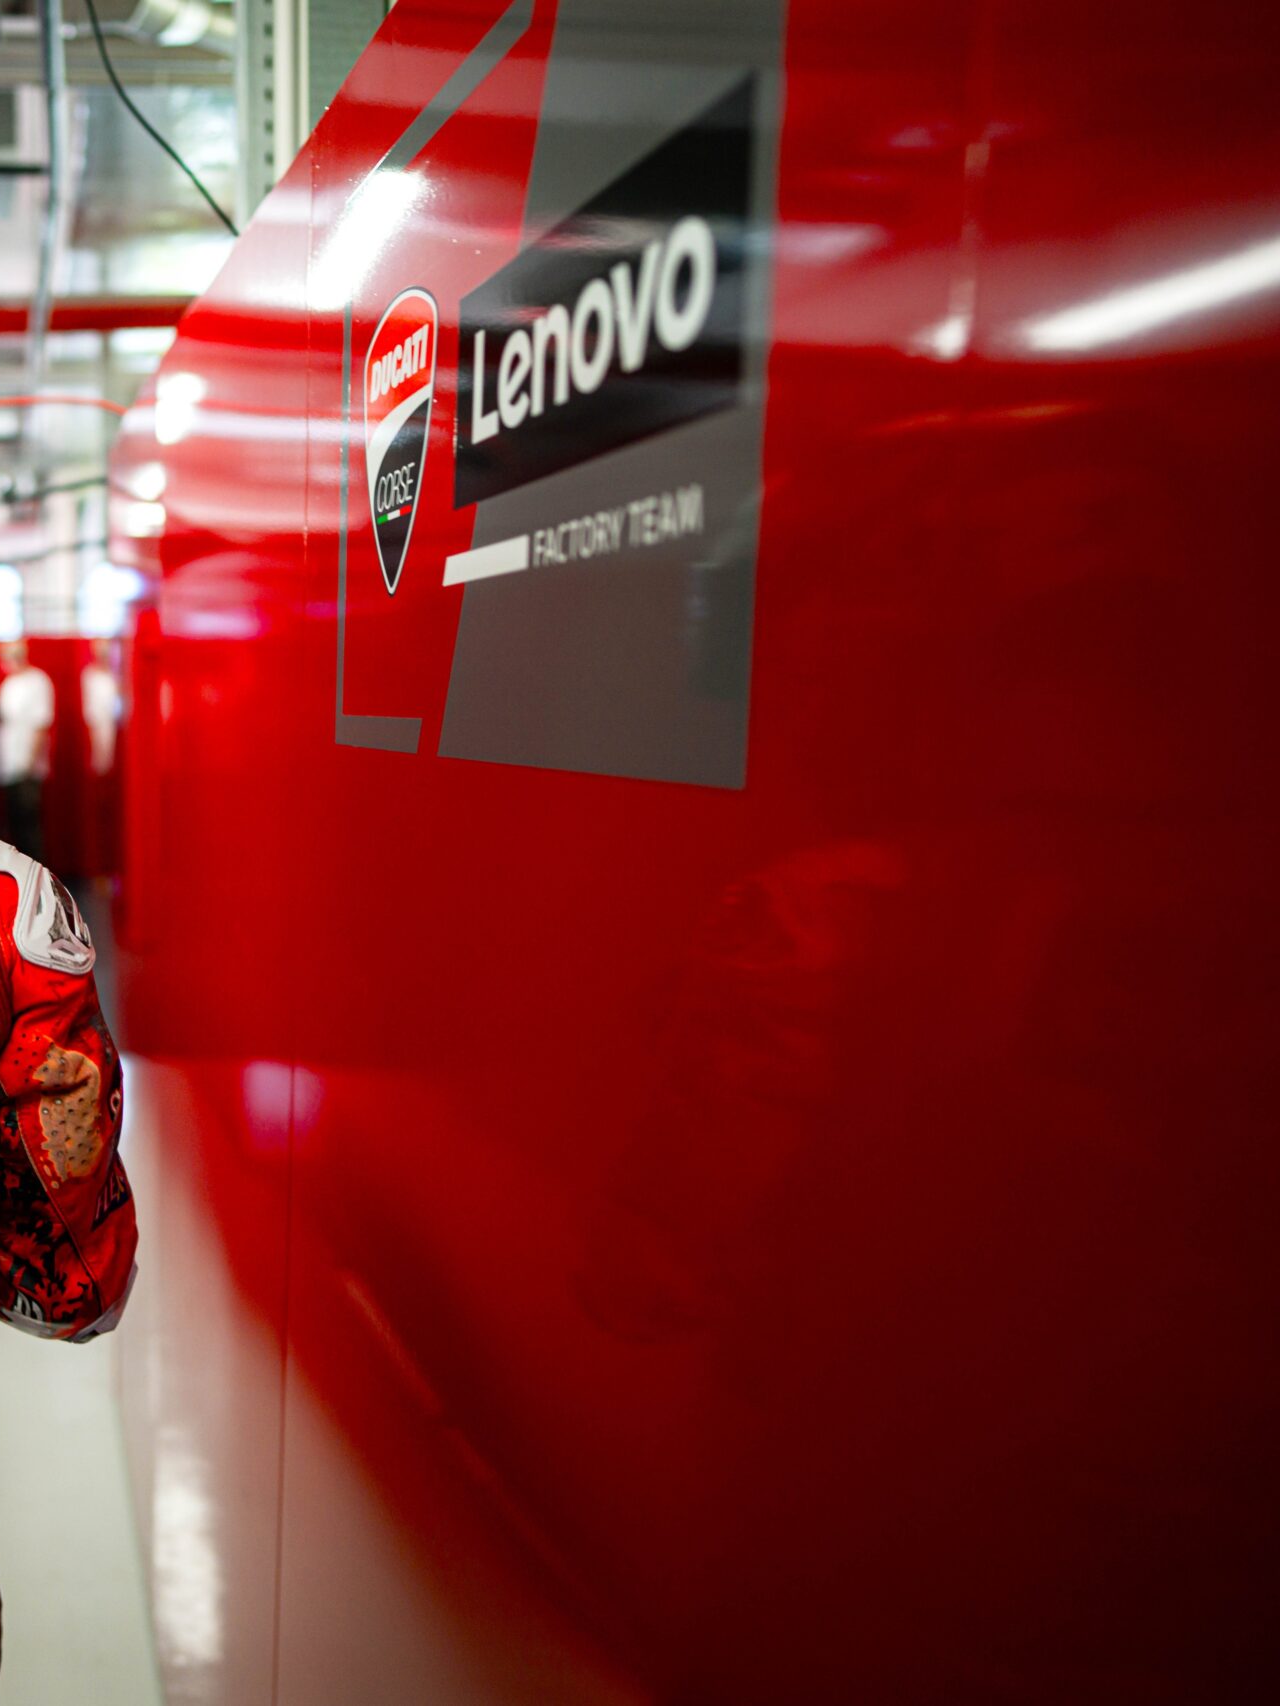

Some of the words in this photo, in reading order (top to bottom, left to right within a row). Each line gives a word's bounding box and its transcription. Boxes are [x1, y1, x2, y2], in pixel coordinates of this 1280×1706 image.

[370, 323, 429, 403] DUCATI
[472, 216, 716, 445] Lenovo
[377, 462, 415, 513] CORSE
[533, 508, 626, 568] FACTORY
[627, 482, 704, 547] TEAM
